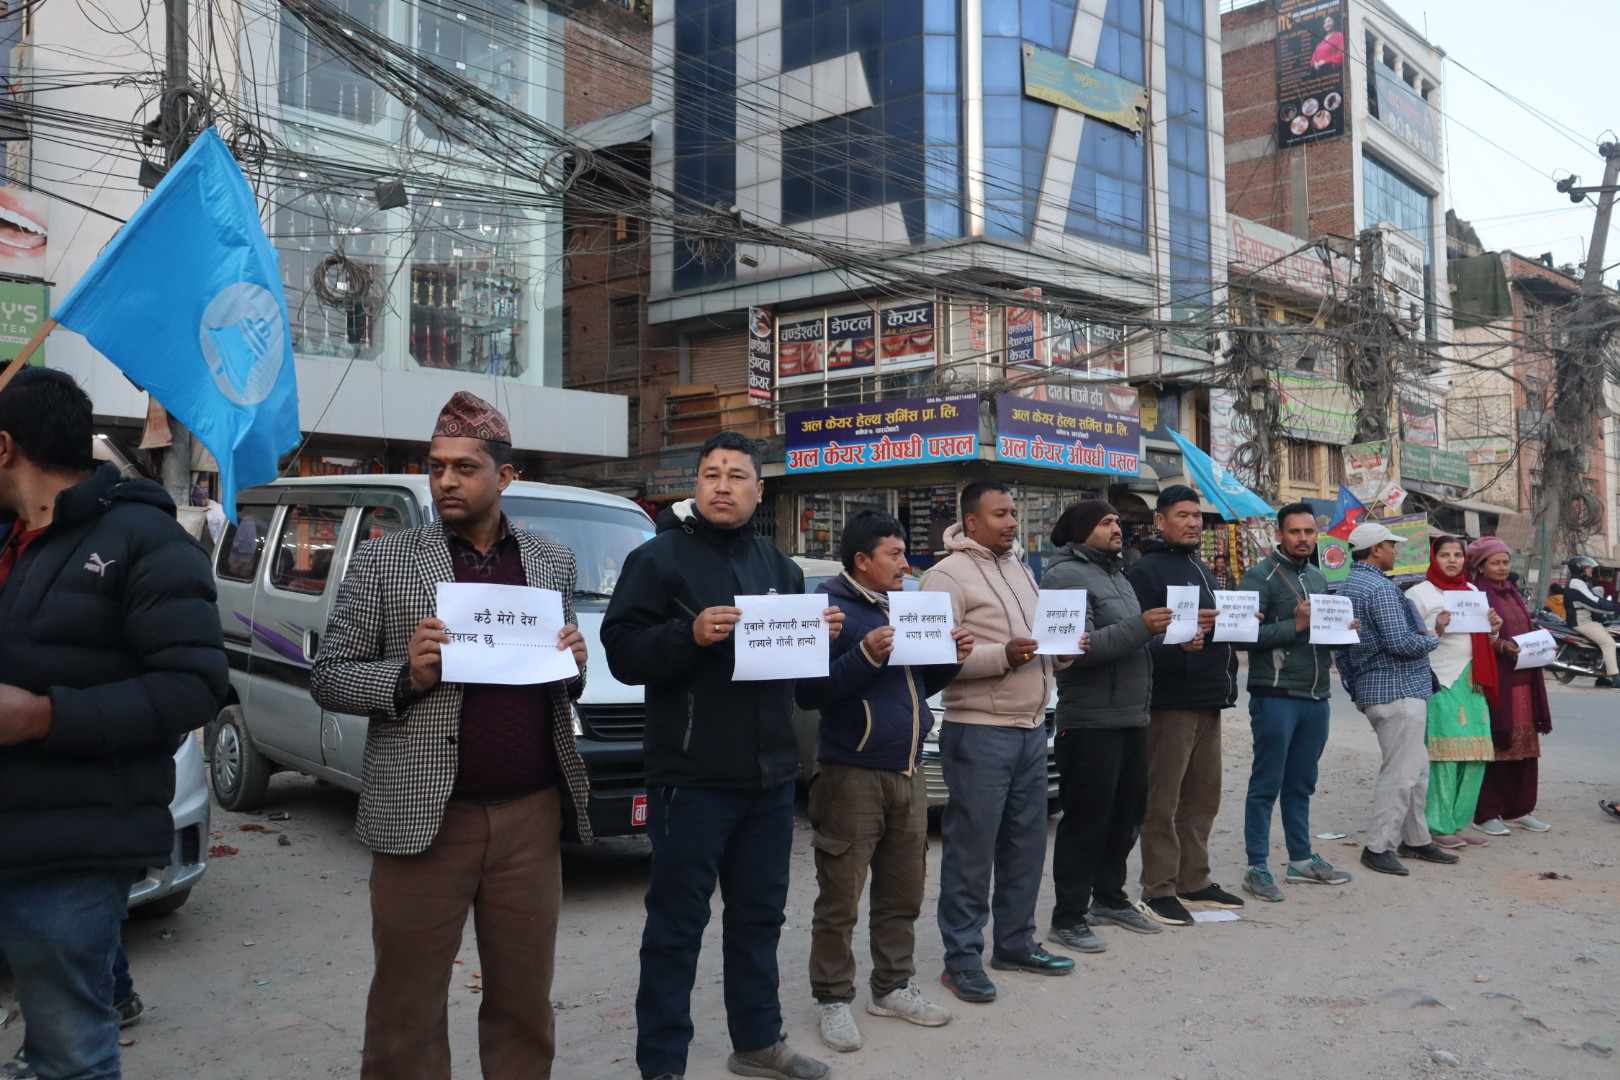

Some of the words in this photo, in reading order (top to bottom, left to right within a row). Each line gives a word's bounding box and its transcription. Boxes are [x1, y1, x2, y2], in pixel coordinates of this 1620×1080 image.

[831, 315, 872, 335] डेण्टल
[887, 307, 928, 326] केयर
[750, 371, 770, 391] केयर
[801, 419, 822, 433] अल
[825, 415, 854, 430] केयर
[856, 412, 882, 428] हेल्थ
[922, 407, 937, 422] प्रा.
[940, 403, 959, 419] लि.
[1011, 408, 1031, 424] अल
[1032, 408, 1054, 426] केयर
[1057, 412, 1076, 429] हेल्थ
[1116, 421, 1129, 437] लि.
[789, 447, 820, 469] अल
[823, 440, 867, 466] केयर
[871, 433, 923, 462] औषधी
[928, 434, 977, 458] पसल
[1000, 436, 1028, 458] अल
[1031, 434, 1064, 464] केयर
[1067, 439, 1106, 469] औषधी
[1108, 450, 1139, 473] पसल
[473, 608, 492, 625] कठै
[496, 610, 515, 625] मेरो
[520, 611, 538, 627] देश
[744, 619, 766, 635] युवाले
[768, 617, 797, 631] रोजगारी
[801, 617, 821, 629] माग्यो
[748, 636, 773, 649] राज्यले
[776, 634, 793, 648] गोली
[797, 633, 816, 648] हान्यो
